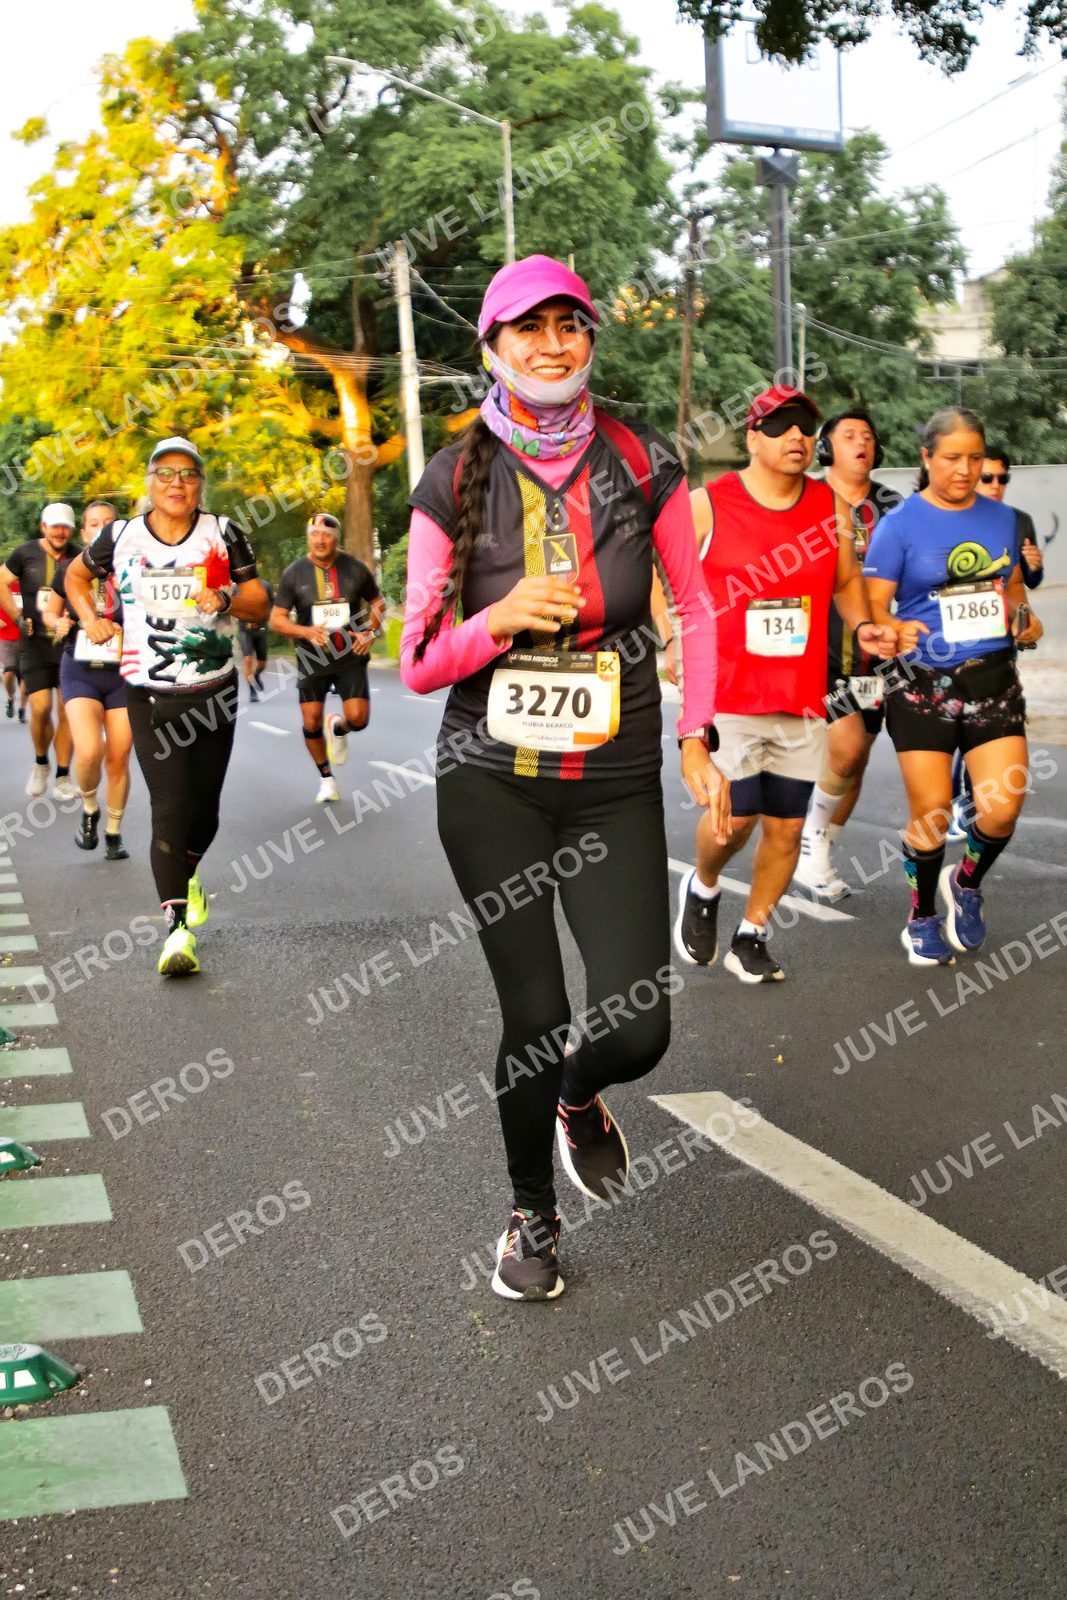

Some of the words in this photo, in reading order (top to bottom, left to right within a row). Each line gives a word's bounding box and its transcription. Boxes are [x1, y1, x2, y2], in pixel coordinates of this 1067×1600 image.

[150, 584, 193, 601] 1507
[945, 599, 1000, 621] 12865
[763, 616, 796, 636] 134
[599, 661, 615, 672] 5K
[504, 682, 593, 719] 3270
